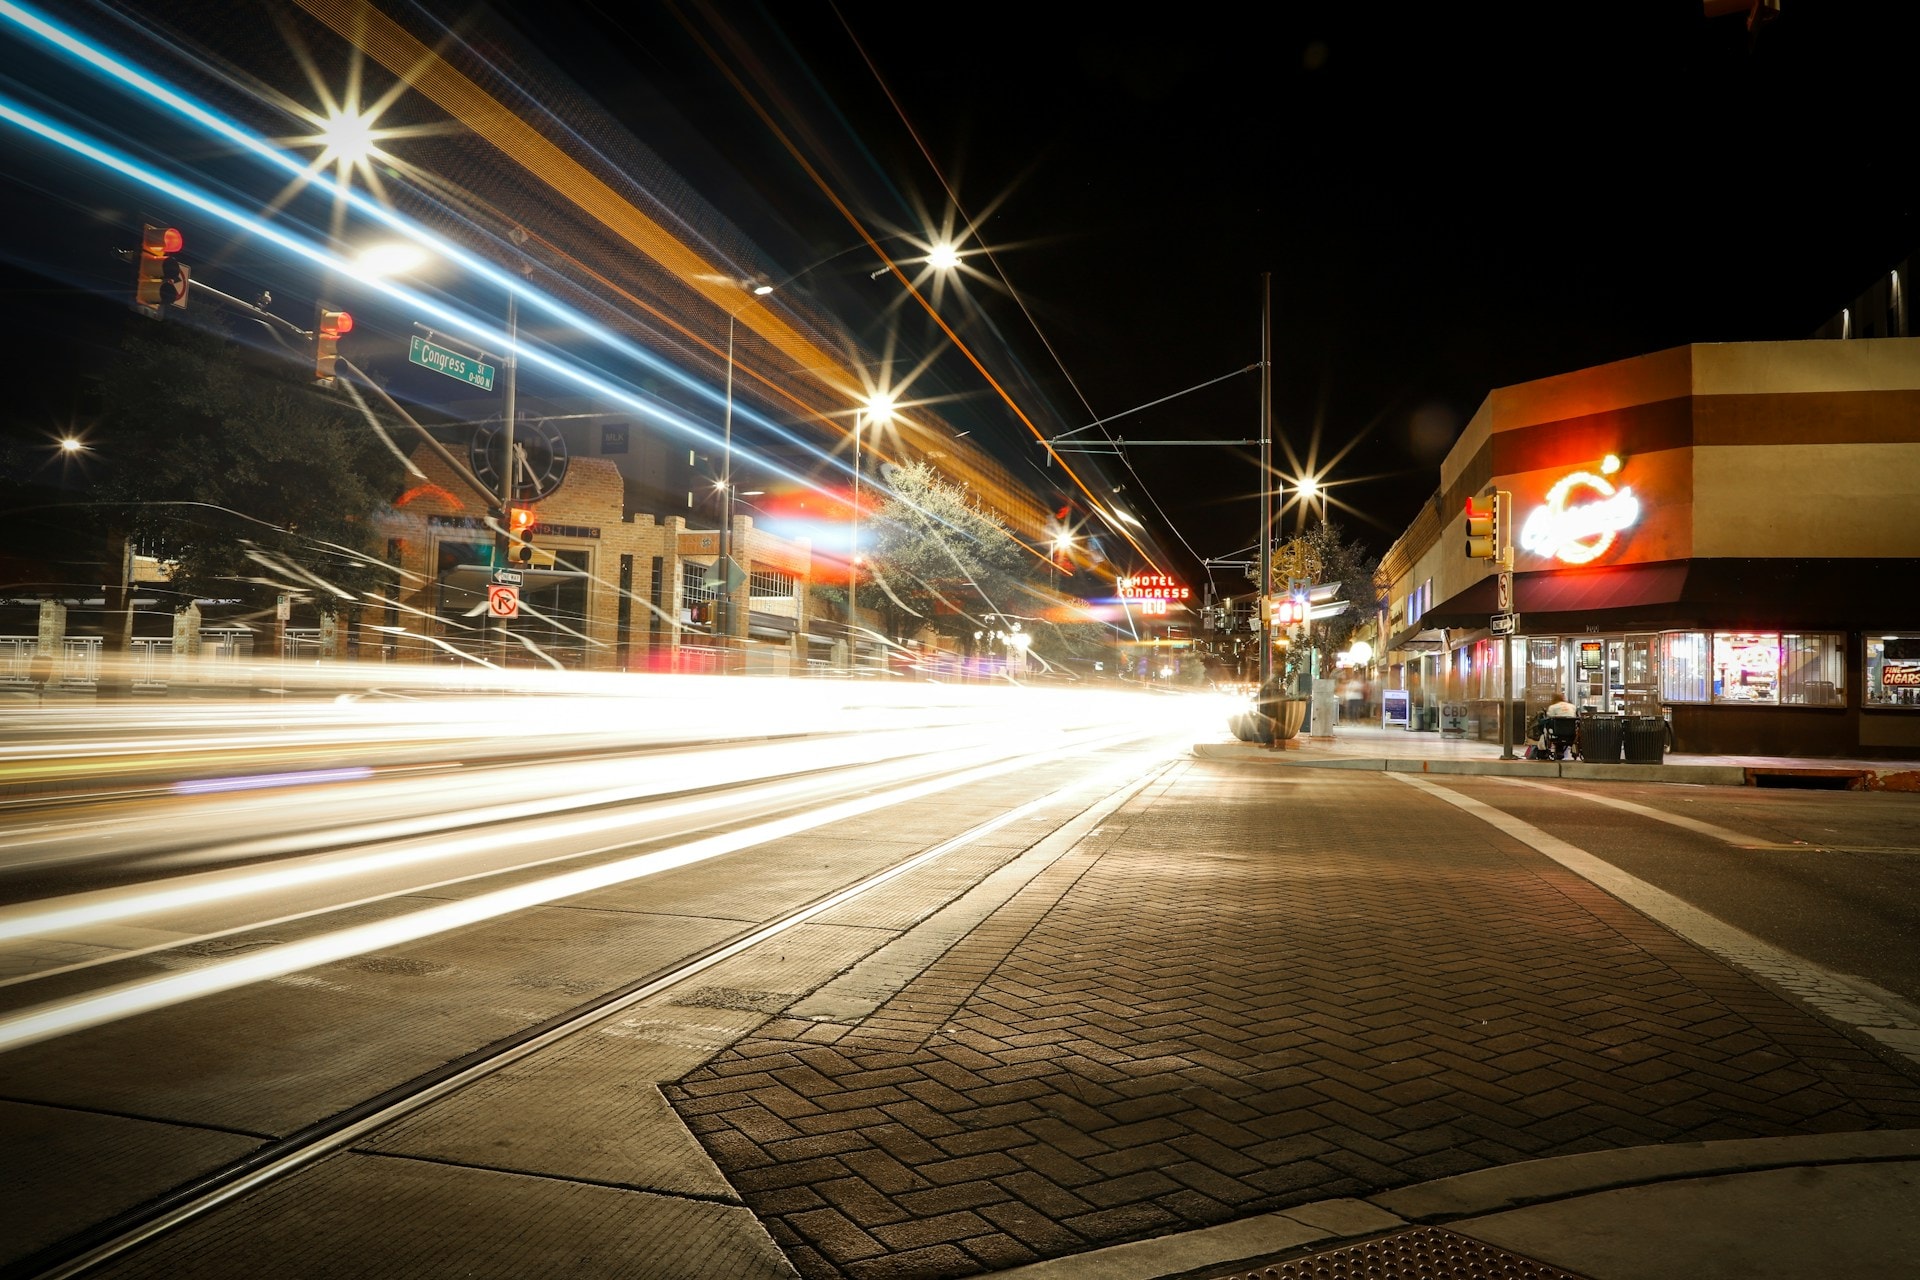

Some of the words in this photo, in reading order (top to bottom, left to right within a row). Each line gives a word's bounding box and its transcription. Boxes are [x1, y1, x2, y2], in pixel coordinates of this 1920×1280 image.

[414, 340, 420, 350] E
[421, 344, 466, 374] Congress
[477, 364, 485, 375] St
[468, 371, 485, 387] 0-100
[485, 378, 491, 388] N
[1132, 576, 1175, 587] HOTEL
[1119, 588, 1190, 599] CONGRESS
[1884, 666, 1902, 674] FINE
[1883, 673, 1920, 685] CIGARS
[1443, 705, 1468, 718] CBD
